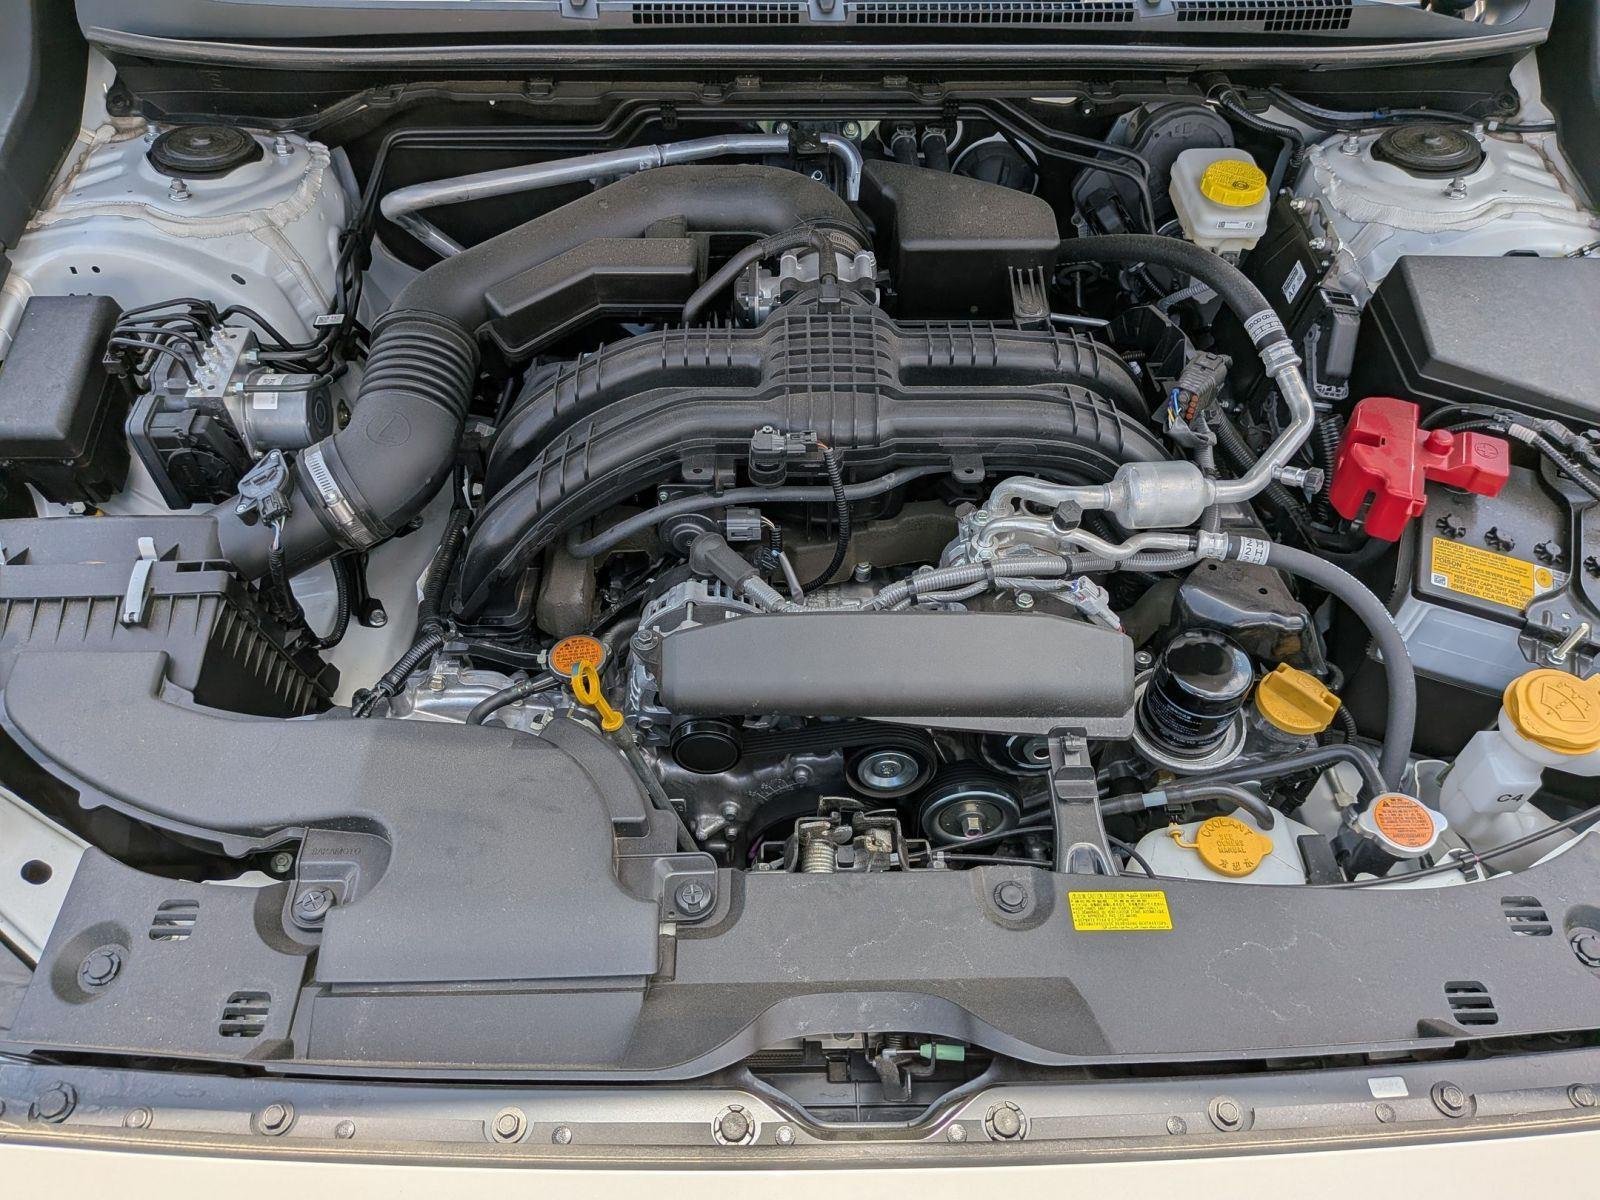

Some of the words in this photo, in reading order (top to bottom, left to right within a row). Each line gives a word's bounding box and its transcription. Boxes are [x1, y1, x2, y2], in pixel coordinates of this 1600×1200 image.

[1435, 540, 1464, 550] DANGER
[1434, 557, 1462, 568] POISON
[1496, 794, 1523, 802] C4
[1200, 818, 1253, 837] COOLANT
